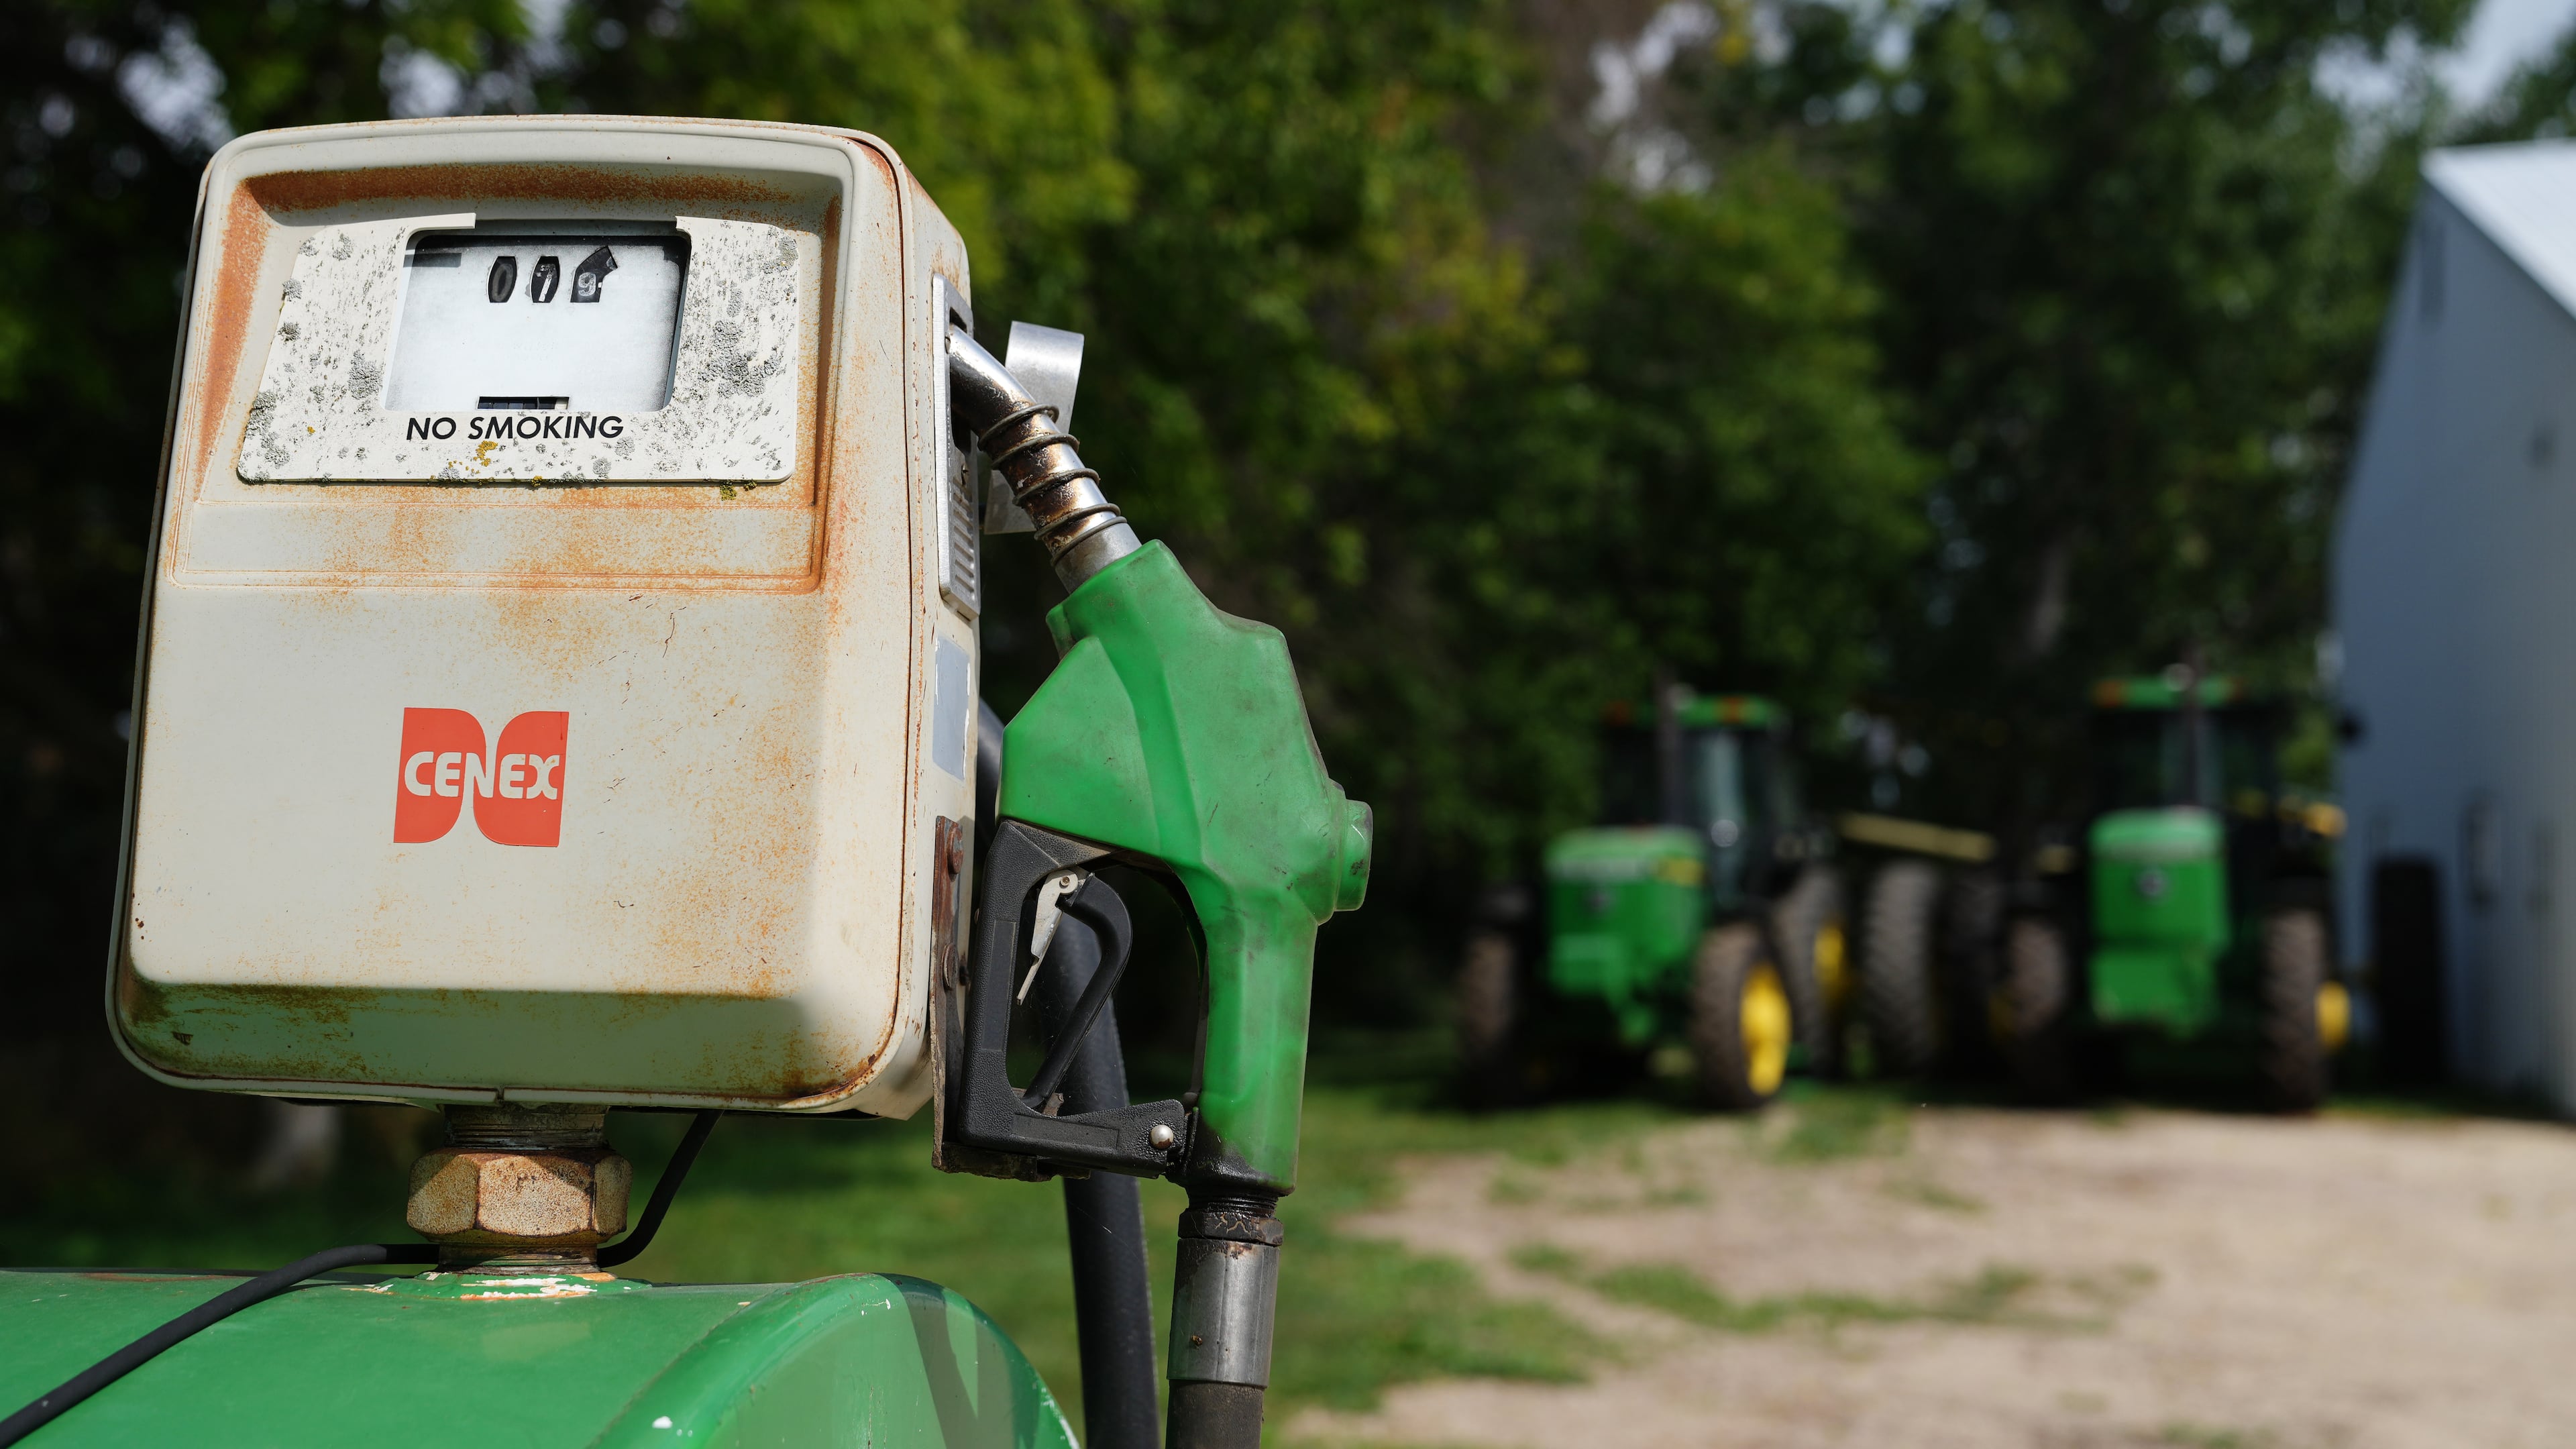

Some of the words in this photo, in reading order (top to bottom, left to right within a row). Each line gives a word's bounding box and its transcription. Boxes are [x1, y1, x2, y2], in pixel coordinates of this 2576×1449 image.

[406, 417, 457, 440] NO
[468, 416, 624, 439] SMOKING
[404, 751, 561, 800] CENEX
